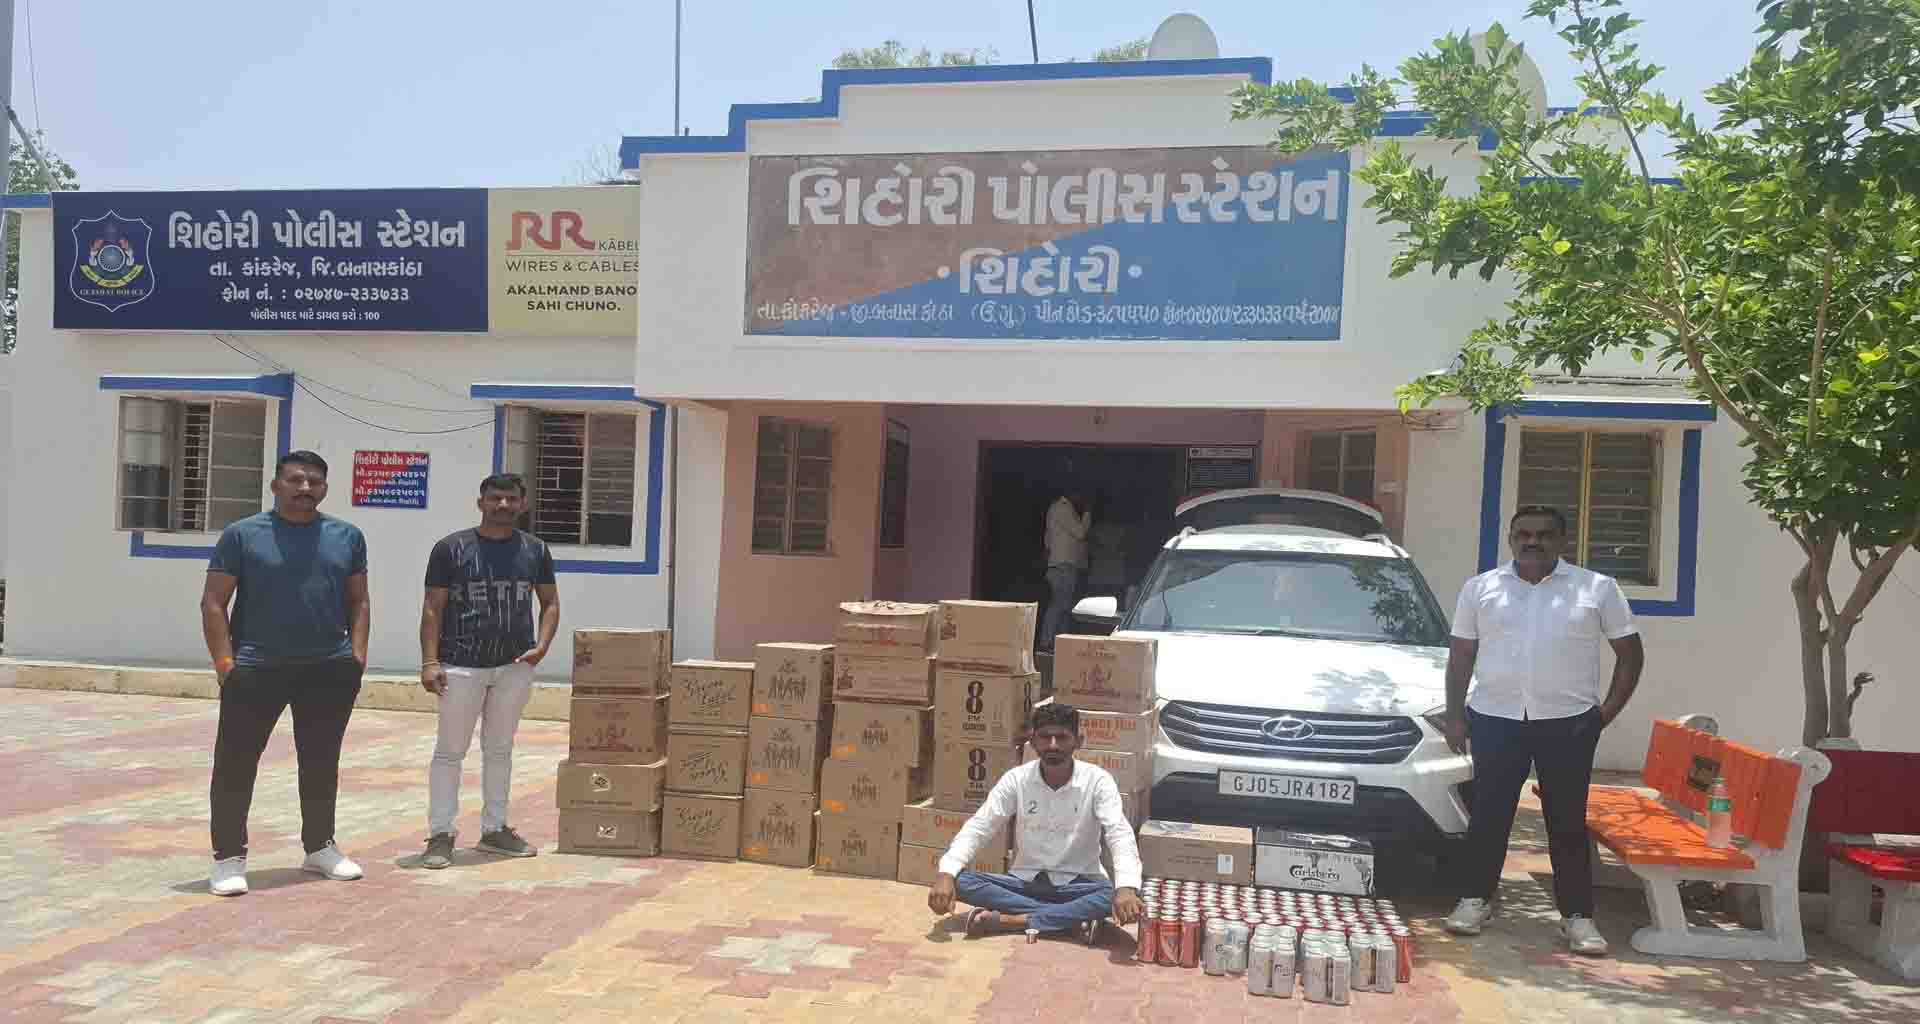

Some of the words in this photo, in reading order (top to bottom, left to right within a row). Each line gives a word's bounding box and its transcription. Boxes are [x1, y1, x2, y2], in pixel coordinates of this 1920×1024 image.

[788, 162, 975, 226] શિહોરી
[987, 160, 1166, 224] પોલીસ
[1171, 156, 1341, 223] સ્ટેશન
[168, 209, 259, 250] શિહોરી
[272, 209, 362, 248] પોલીસ
[377, 208, 465, 248] સ્ટેશન
[506, 211, 595, 250] RR
[209, 262, 231, 277] તા.
[241, 256, 300, 279] કાંકરેજ,
[506, 260, 558, 272] WIRES
[562, 261, 572, 272] &
[960, 240, 1120, 296] શિહોરી
[221, 283, 249, 301] ફોન
[256, 283, 273, 300] નં.
[294, 287, 409, 301] ૦૨૭૪૭-૨૩૩૭૩૩
[507, 285, 589, 296] AKALMAND
[594, 285, 638, 296] BANO
[250, 307, 278, 320] પોલીસ
[280, 311, 297, 320] મદદ
[299, 307, 314, 320] માટે
[316, 311, 340, 320] ડાયલ
[342, 307, 357, 320] કરો
[364, 311, 380, 320] 100
[527, 300, 561, 311] SAHI
[566, 300, 621, 311] CHUNO.
[966, 681, 984, 714] 8
[968, 748, 986, 781] 8
[1233, 776, 1352, 801] GJ05JR4182
[1289, 864, 1340, 881] Carlsberg
